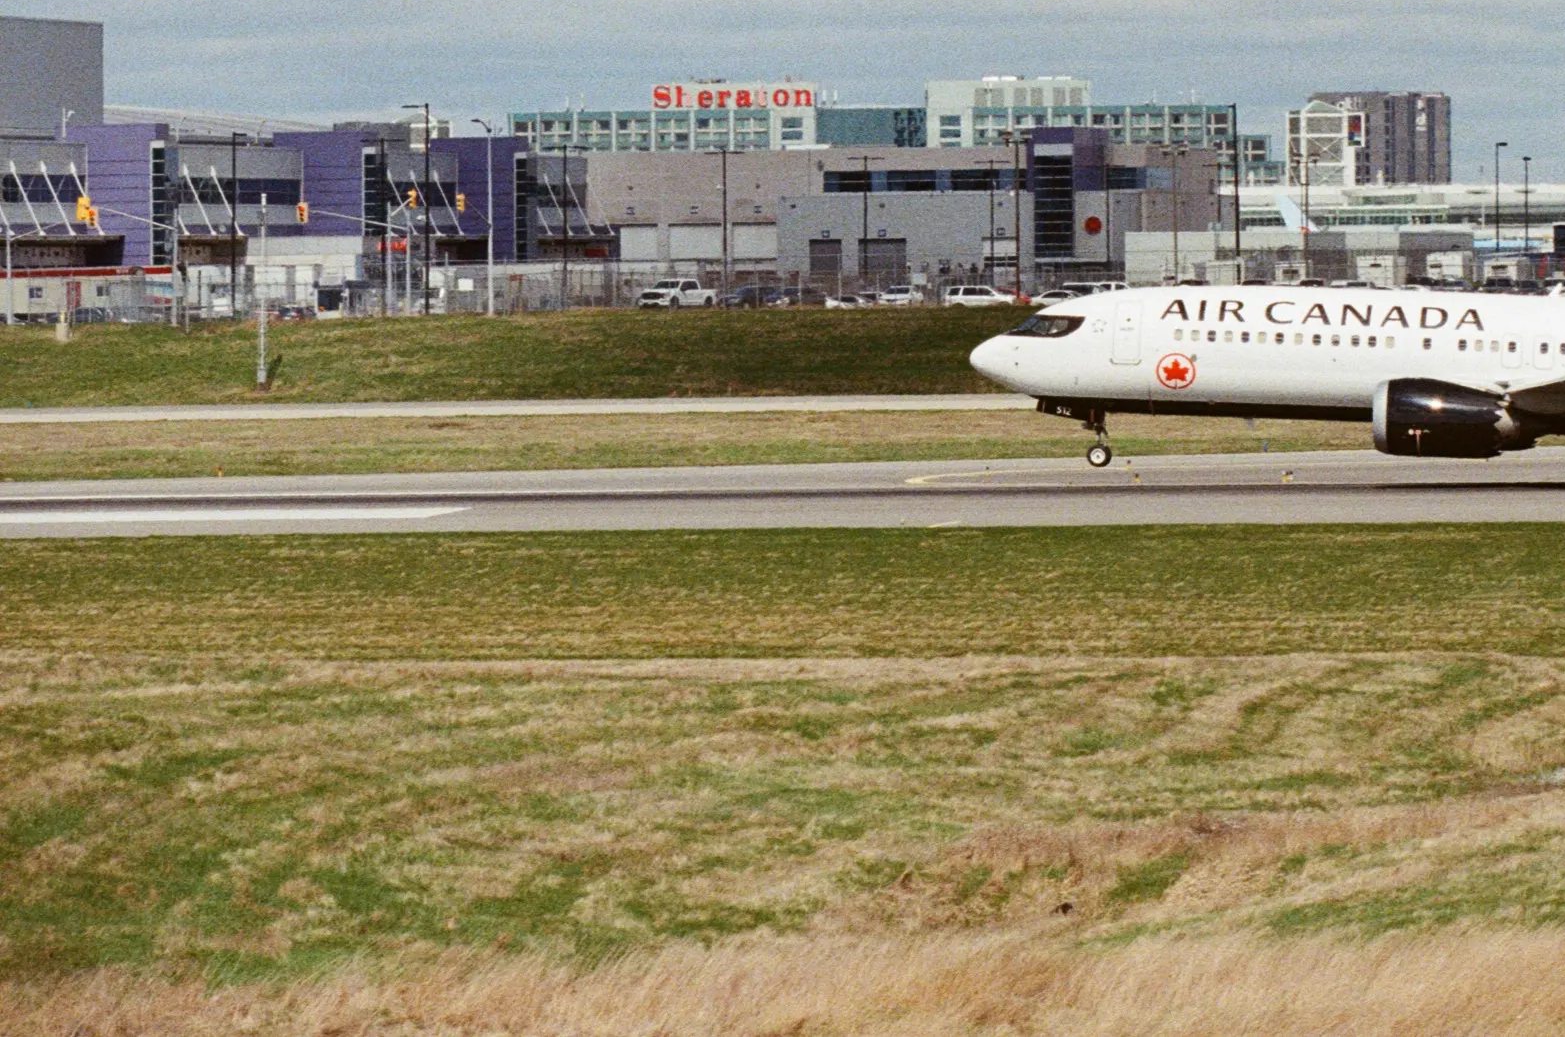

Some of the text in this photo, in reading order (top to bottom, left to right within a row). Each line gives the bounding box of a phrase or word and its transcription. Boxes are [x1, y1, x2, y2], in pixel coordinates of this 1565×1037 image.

[653, 85, 813, 109] Sheraton
[1160, 298, 1486, 332] AIR CANADA
[1056, 406, 1072, 416] 512
